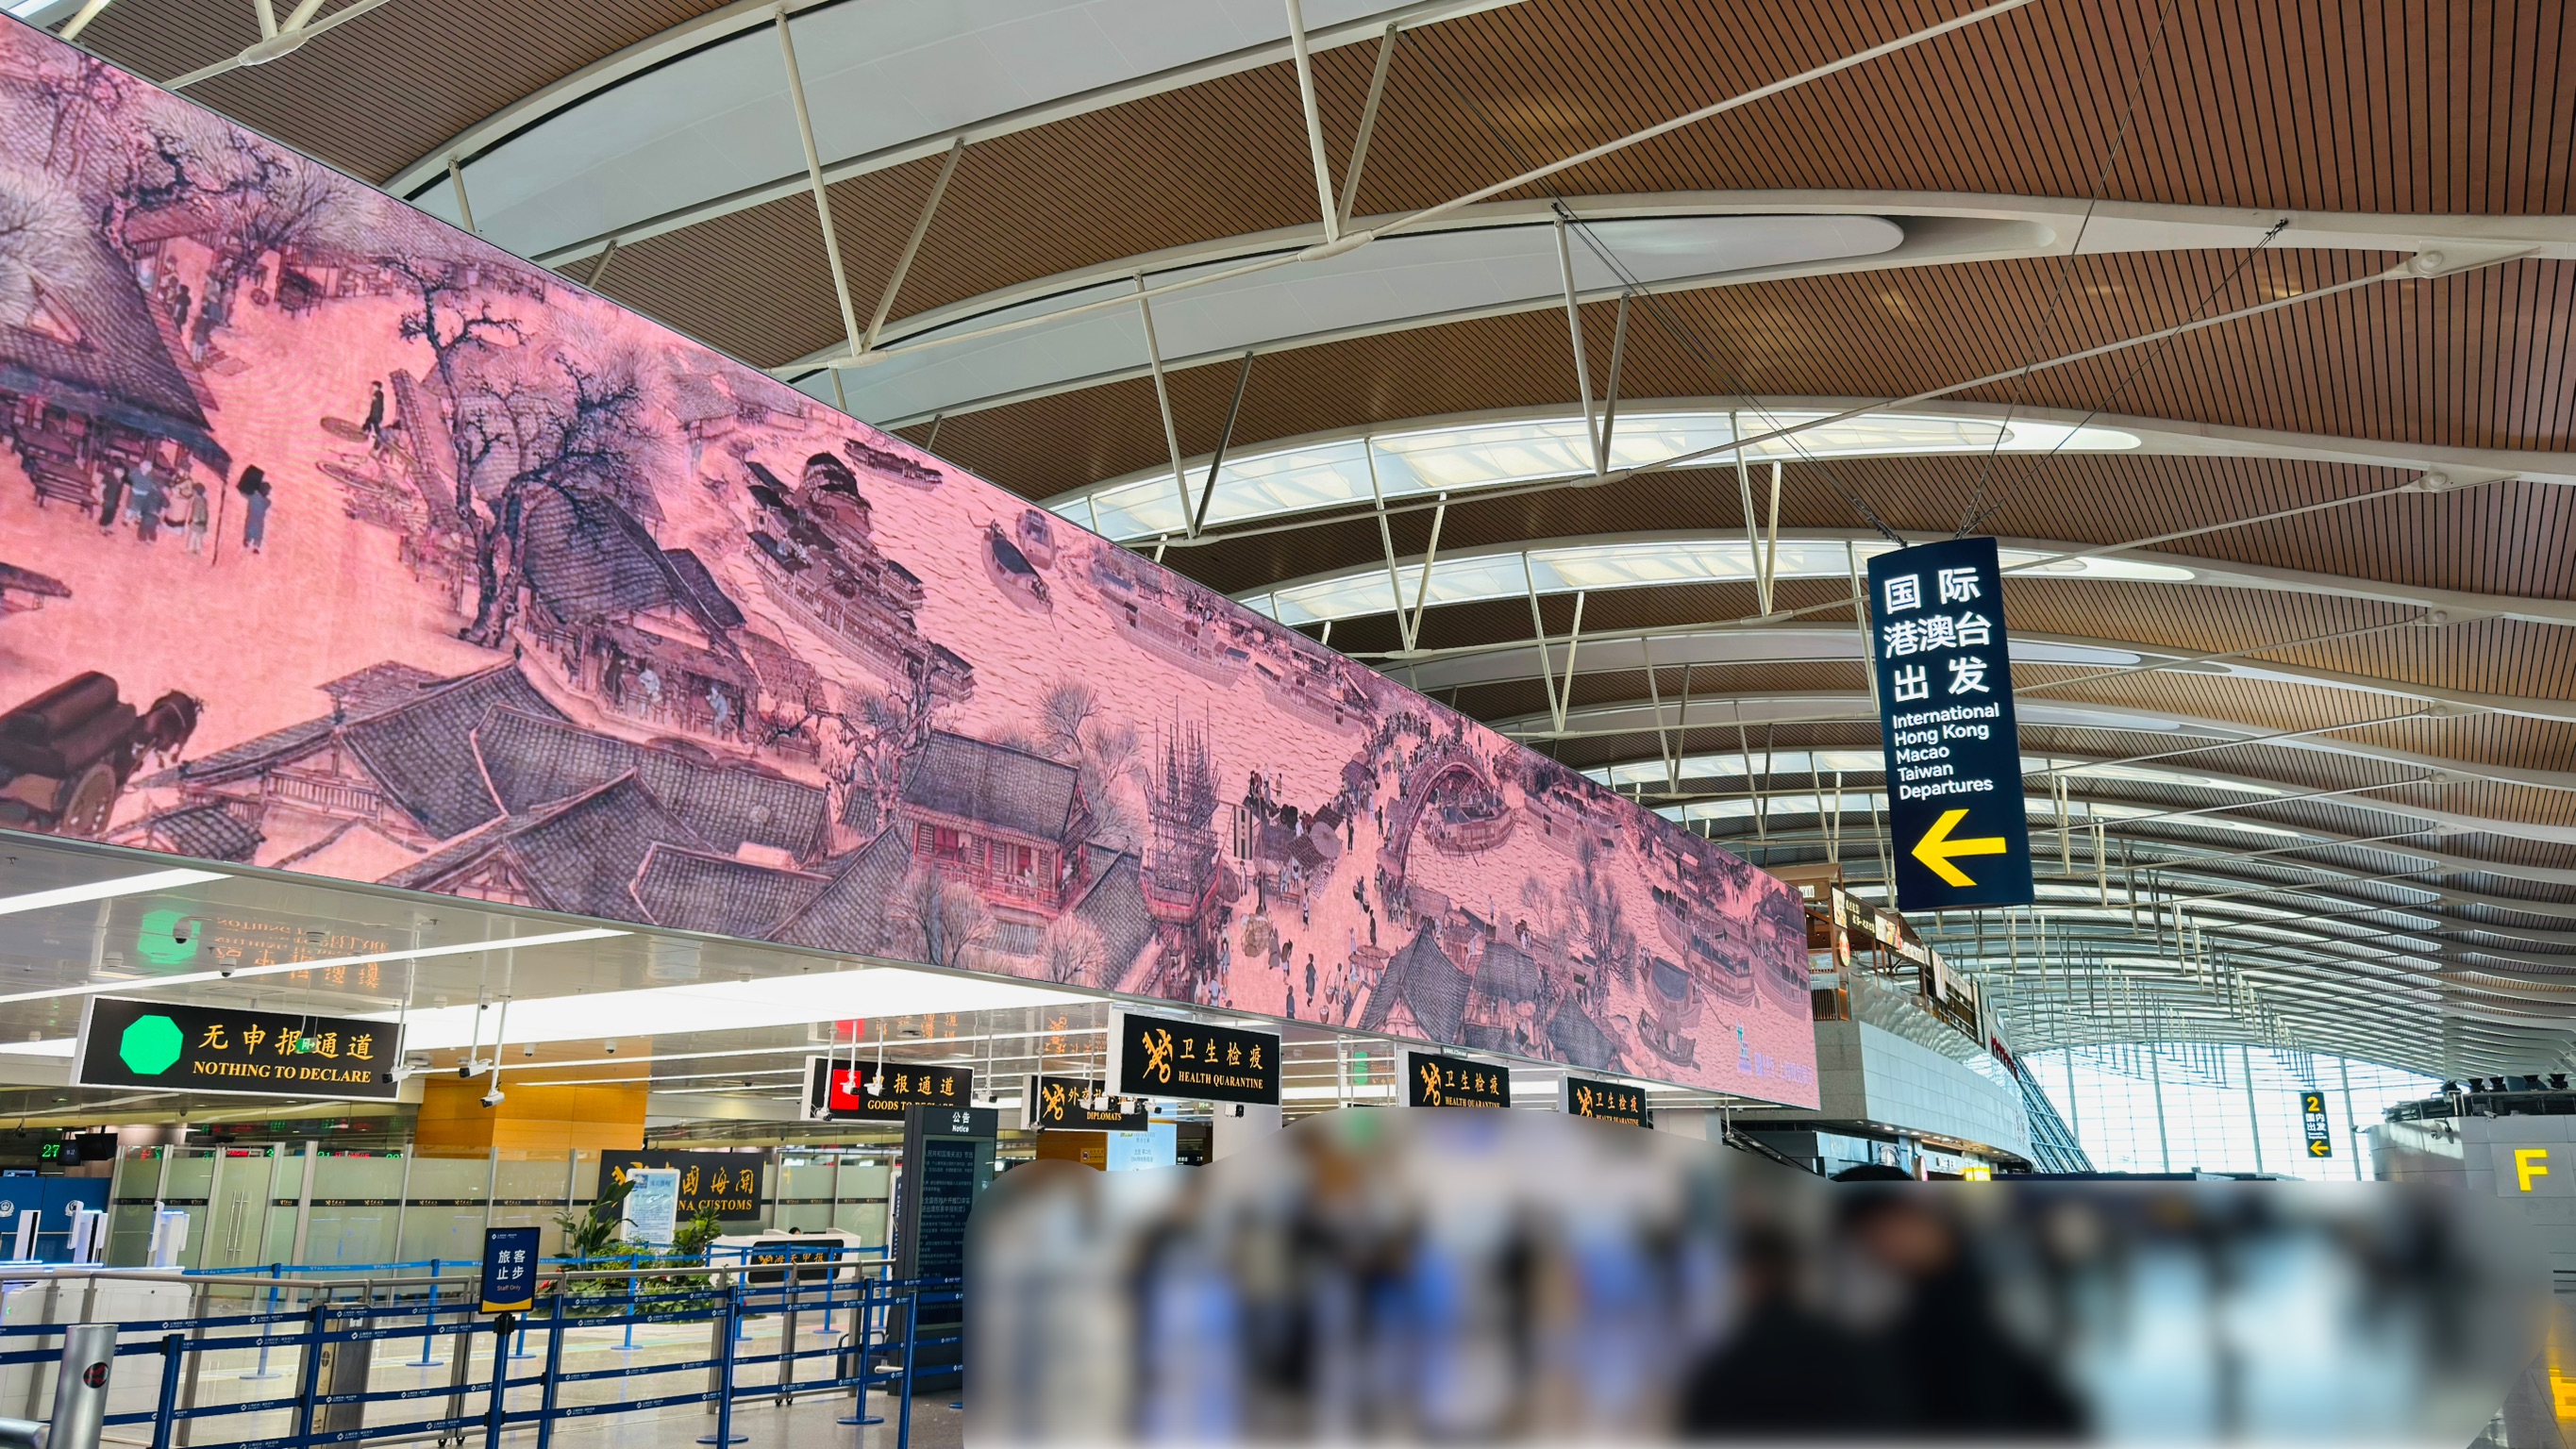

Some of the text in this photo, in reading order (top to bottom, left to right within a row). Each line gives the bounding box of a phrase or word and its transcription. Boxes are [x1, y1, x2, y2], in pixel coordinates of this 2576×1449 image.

[1884, 566, 1981, 615] 国际
[1882, 610, 1992, 659] 港澳台
[1894, 656, 1990, 704] 出发
[1893, 702, 1999, 729] International
[1895, 723, 1990, 748] Hong Kong
[1896, 743, 1950, 765] Macao
[1898, 762, 1953, 782] Taiwan
[1899, 776, 1994, 802] Departures
[198, 1024, 374, 1061] 无申报通道
[1179, 1038, 1263, 1070] 卫生检疫
[192, 1060, 372, 1084] NOTHING TO DECLARE
[1179, 1071, 1263, 1090] HEALTH QUARANTINE
[1445, 1070, 1500, 1096] 卫生检疫
[867, 1100, 899, 1111] GOODS
[1445, 1096, 1500, 1108] HEALTH QUARANTINE
[1596, 1091, 1639, 1113] 卫生检疫
[2306, 1096, 2320, 1112] 2
[952, 1111, 971, 1124] 公告
[1086, 1111, 1122, 1122] DIPLOMATS
[952, 1124, 970, 1133] Notice
[42, 1144, 60, 1158] 27
[2514, 1148, 2548, 1191] F
[698, 1199, 753, 1210] CUSTOMS
[497, 1249, 526, 1263] 旅客
[496, 1265, 524, 1280] 止步
